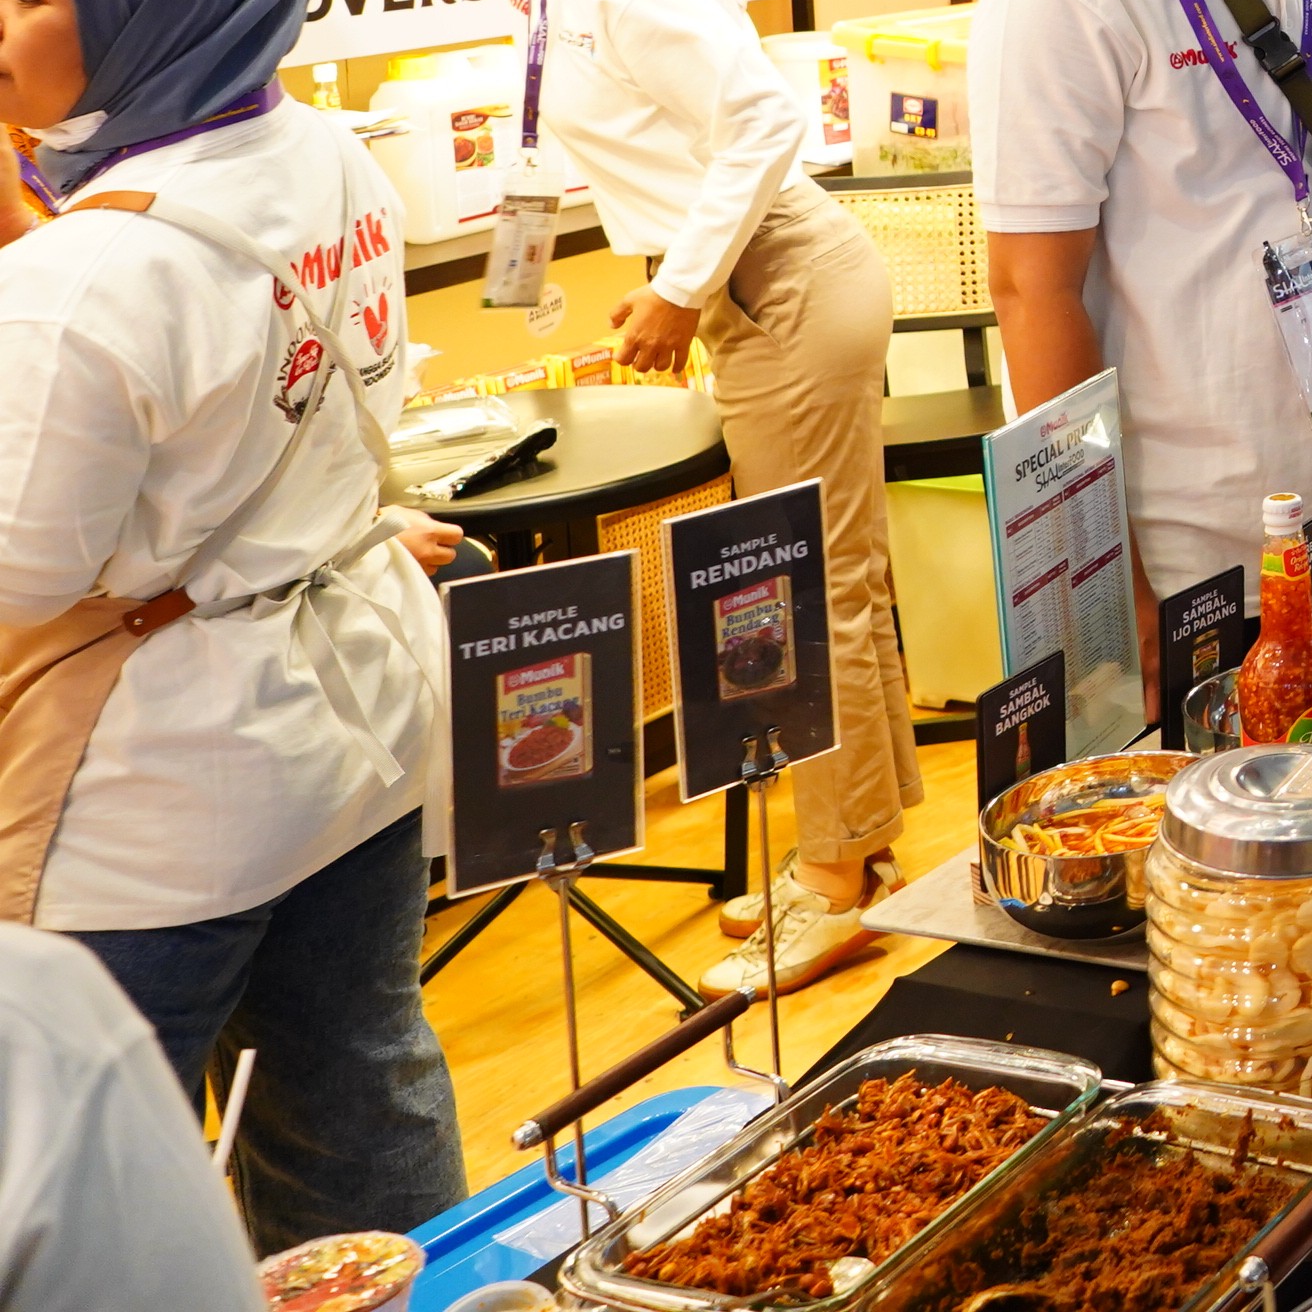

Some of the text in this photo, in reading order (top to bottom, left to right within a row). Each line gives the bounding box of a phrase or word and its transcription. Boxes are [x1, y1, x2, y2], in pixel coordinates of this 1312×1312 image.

[1182, 40, 1238, 67] Muk
[300, 210, 391, 290] Muik
[579, 348, 612, 369] Munik
[1014, 418, 1097, 483] SPECIAL PRIC
[720, 532, 777, 559] SAMPLE
[690, 540, 808, 589] RENDANG
[732, 585, 770, 610] Munik
[1182, 594, 1227, 624] SAMBAL
[1191, 588, 1218, 608] SAMPLE
[508, 605, 578, 630] SAMPLE
[721, 614, 780, 638] Rendang
[726, 603, 774, 626] Bumbu
[1172, 601, 1237, 643] IJO PADANG
[459, 613, 626, 660] TERI KACANG
[520, 662, 565, 685] Munik
[516, 686, 563, 705] Bumbu
[999, 683, 1047, 719] SAMBAL
[1008, 677, 1038, 699] SAMPLE
[499, 707, 527, 723] Teri
[995, 693, 1051, 737] BANGKOK
